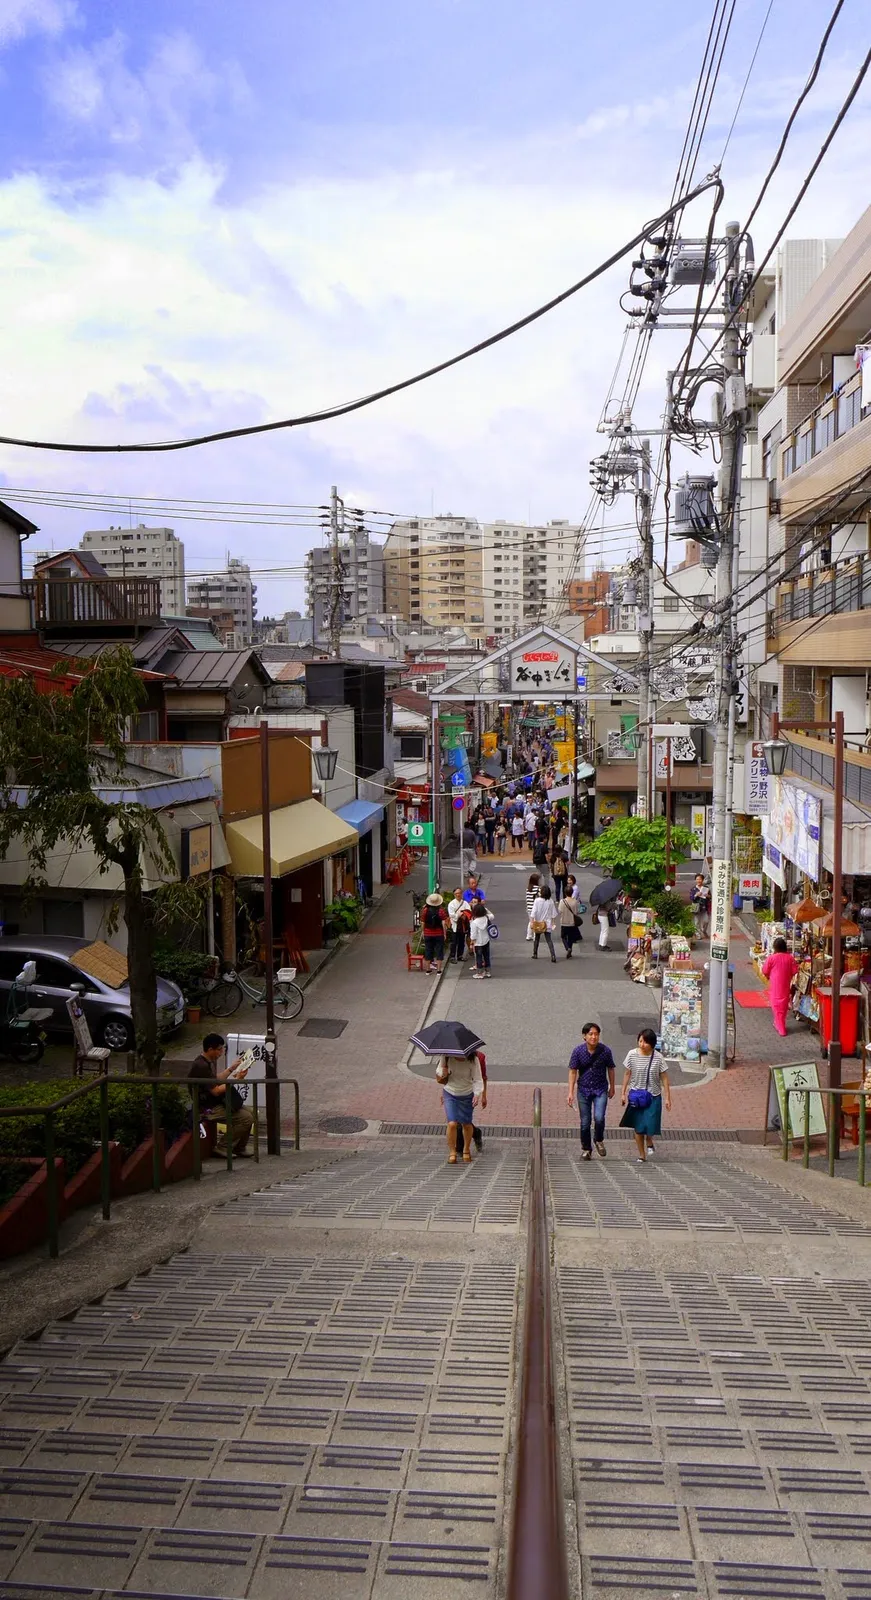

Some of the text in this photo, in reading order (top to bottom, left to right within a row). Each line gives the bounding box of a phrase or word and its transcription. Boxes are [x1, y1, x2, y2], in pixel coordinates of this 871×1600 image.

[750, 760, 758, 799] クリニック
[715, 862, 727, 933] よみせ通り診療所
[743, 880, 759, 888] 焼肉
